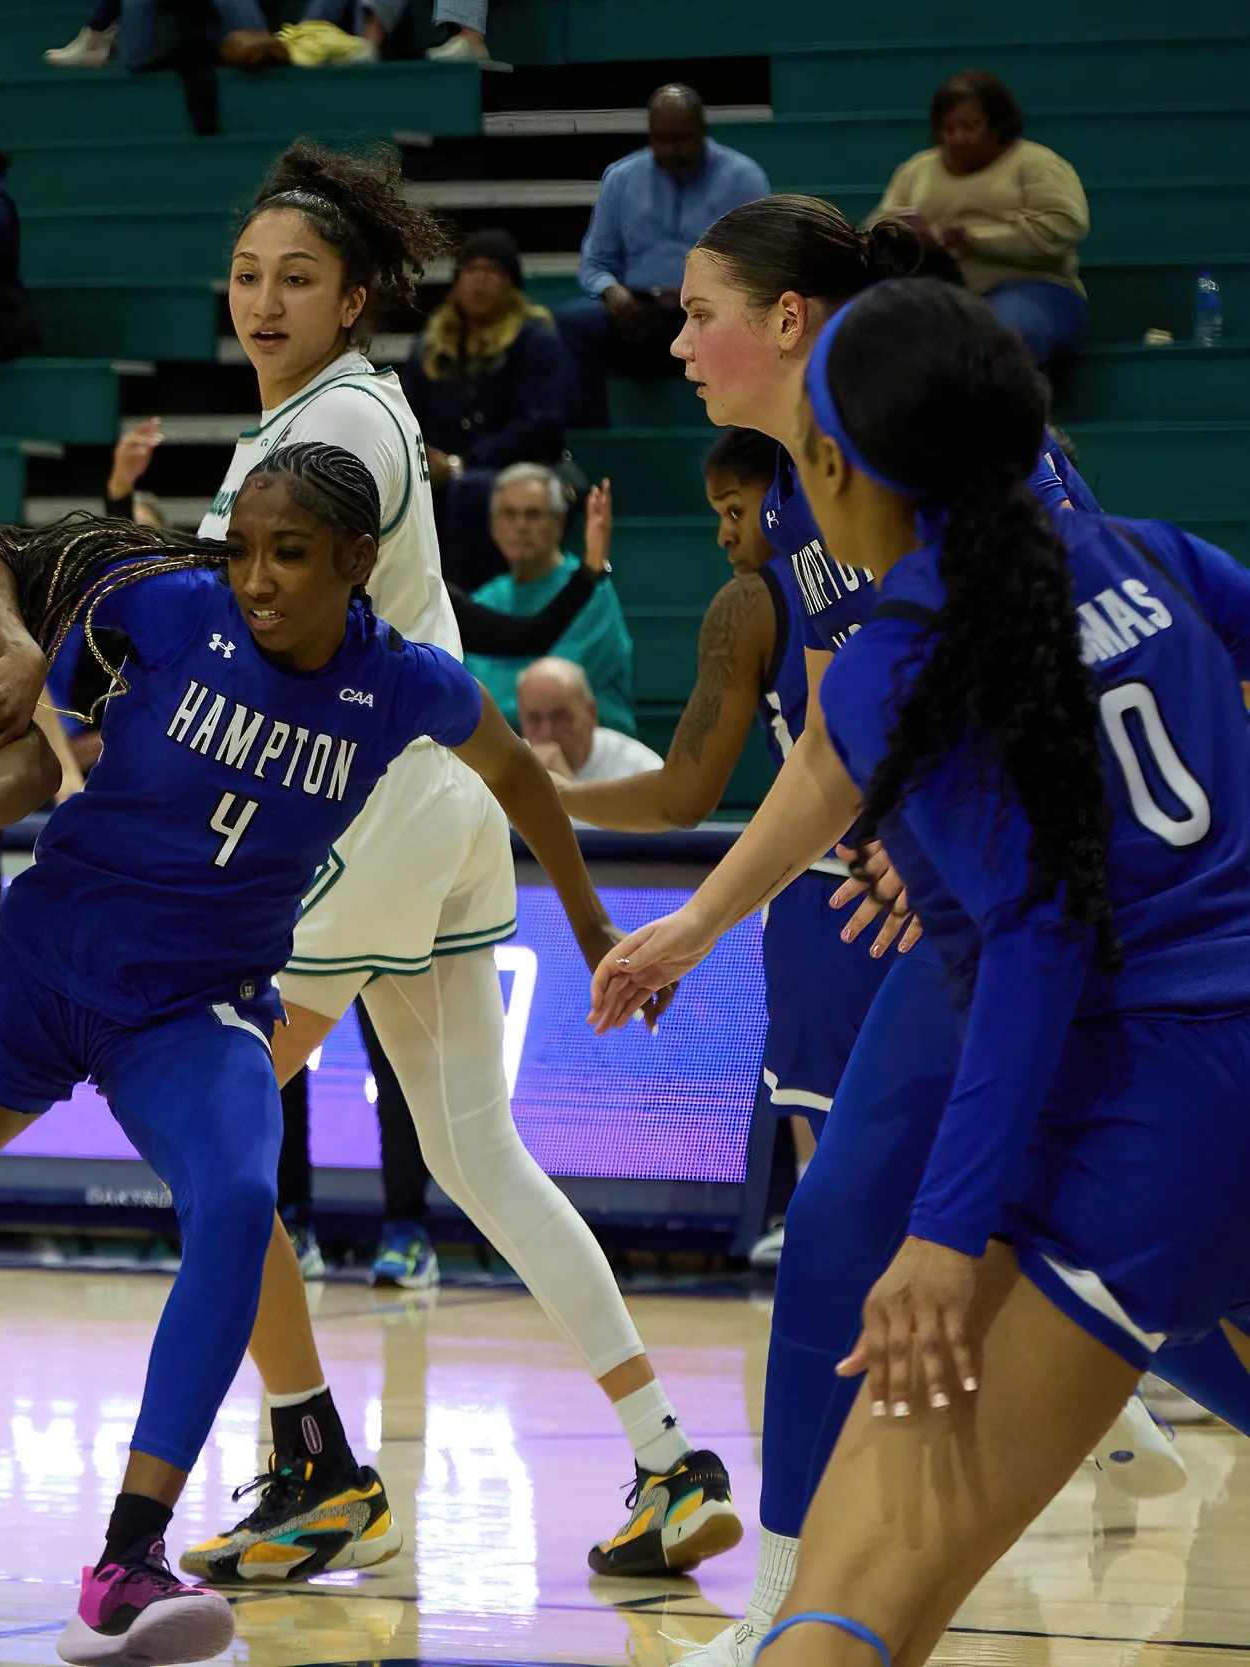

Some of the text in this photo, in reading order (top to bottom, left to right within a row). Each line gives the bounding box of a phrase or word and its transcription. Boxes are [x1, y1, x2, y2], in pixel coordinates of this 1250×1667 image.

[166, 680, 358, 801] HAMPTON
[338, 688, 374, 708] CAA
[1100, 682, 1212, 847] 0
[210, 792, 259, 868] 4
